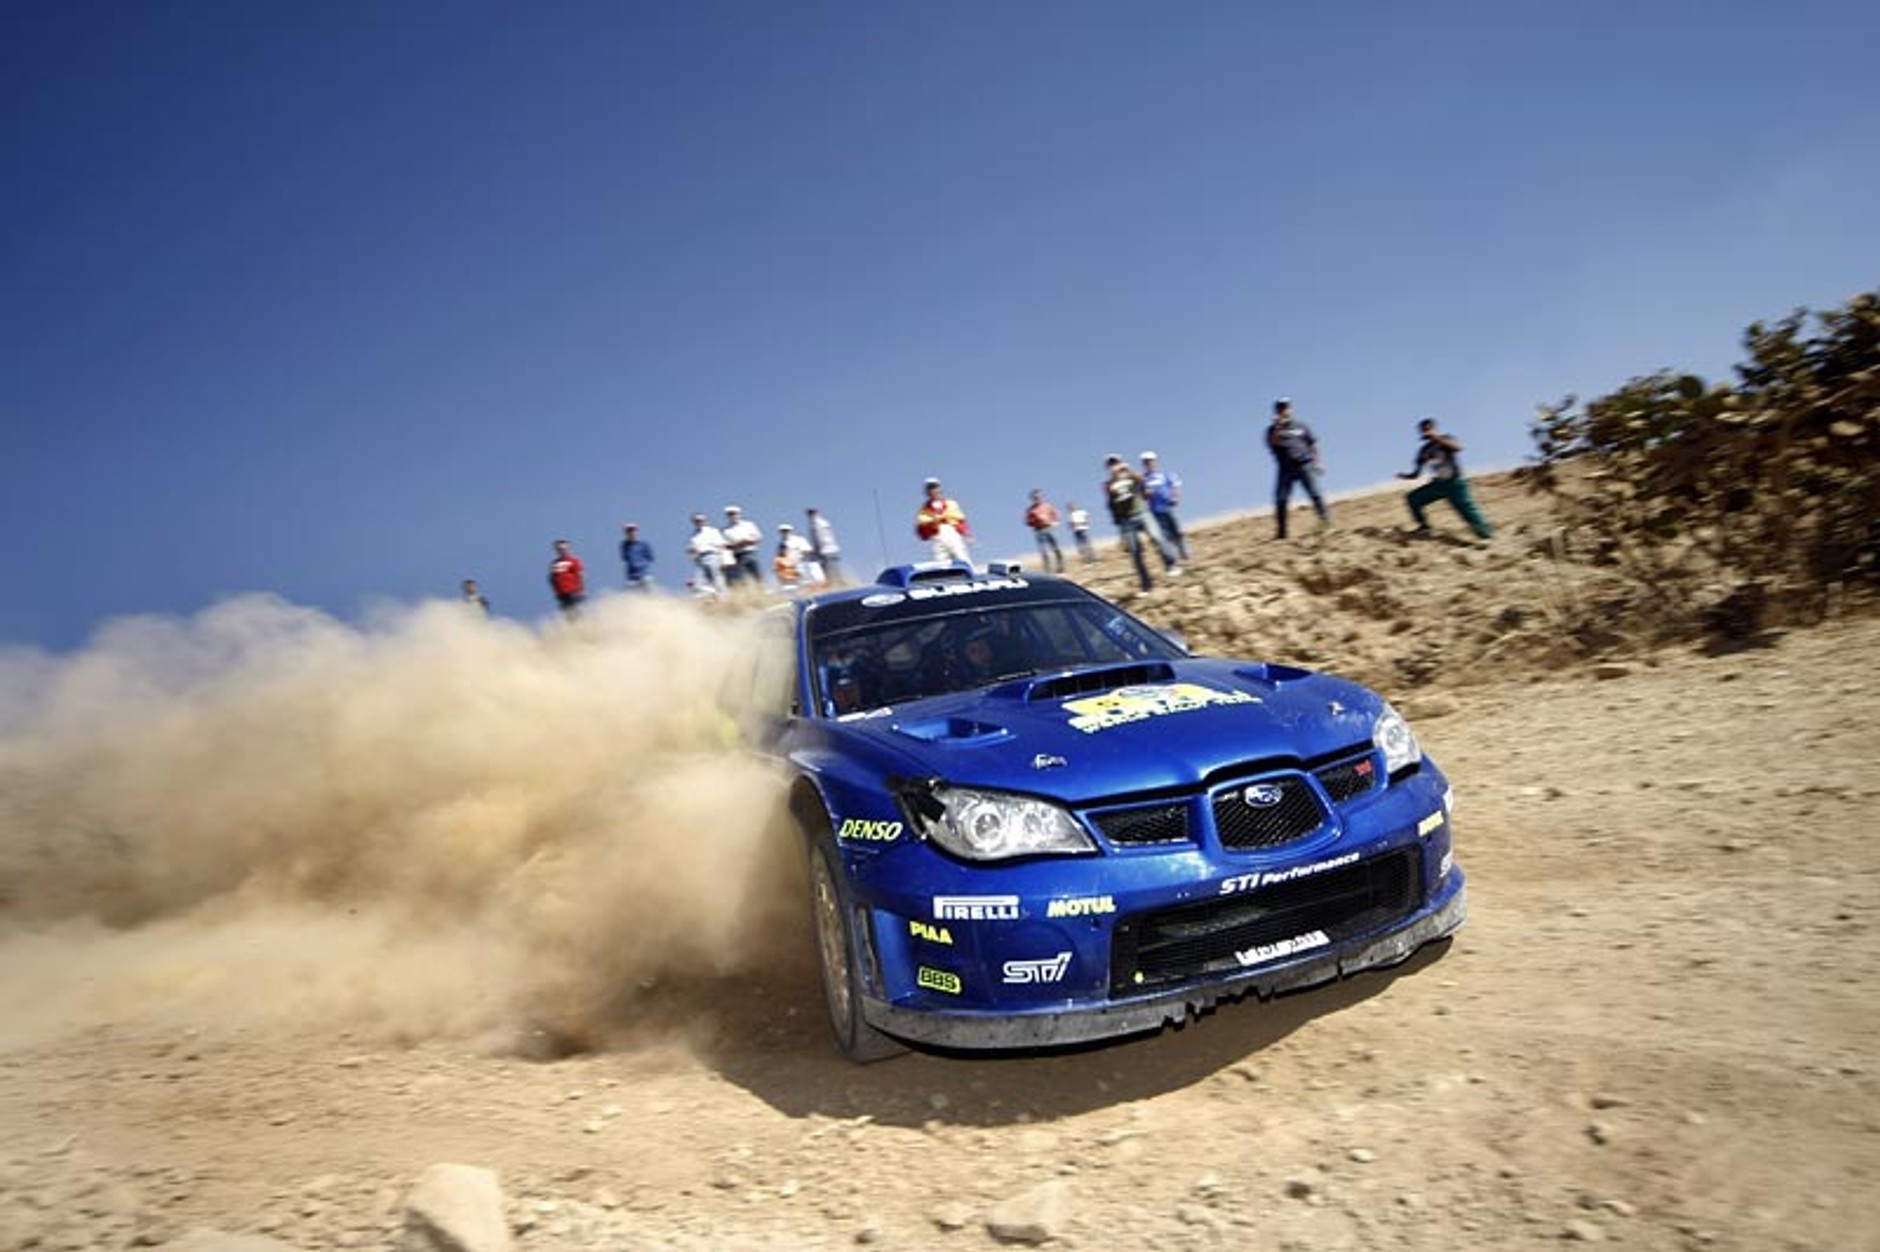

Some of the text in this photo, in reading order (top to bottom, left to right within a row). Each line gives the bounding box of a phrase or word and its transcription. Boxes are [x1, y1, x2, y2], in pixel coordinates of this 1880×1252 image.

[839, 819, 903, 841] DENSO
[1219, 852, 1360, 895] STI Performance
[933, 895, 1019, 920] PIRELLI
[1046, 896, 1116, 917] MOTUL
[910, 920, 953, 945] PIAA
[919, 967, 960, 993] BBS
